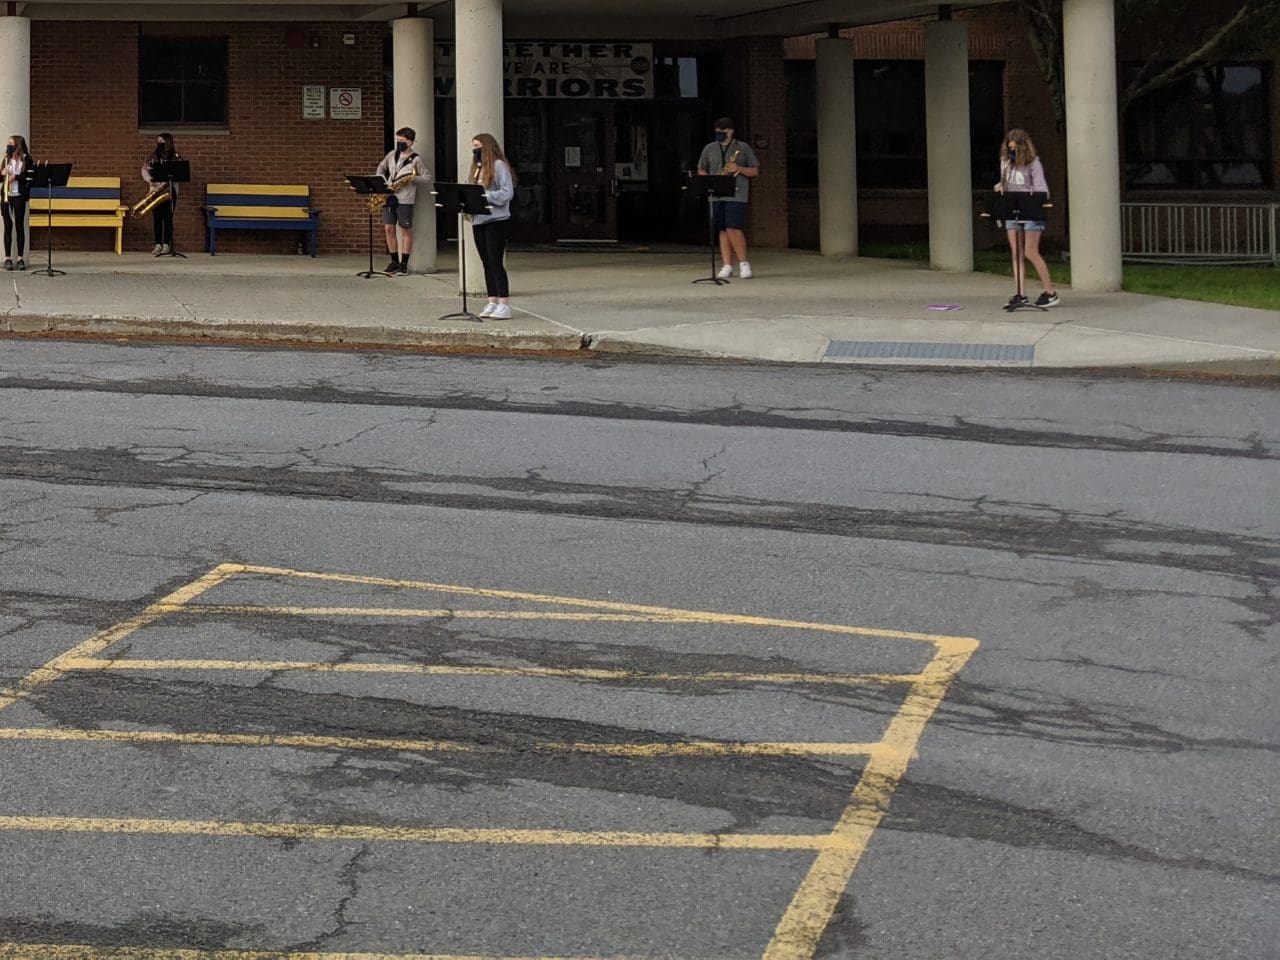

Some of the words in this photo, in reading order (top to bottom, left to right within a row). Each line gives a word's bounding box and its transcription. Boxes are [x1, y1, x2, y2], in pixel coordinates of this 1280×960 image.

[436, 43, 633, 58] TETHER
[533, 61, 570, 74] ARE
[436, 78, 646, 97] WRIORS
